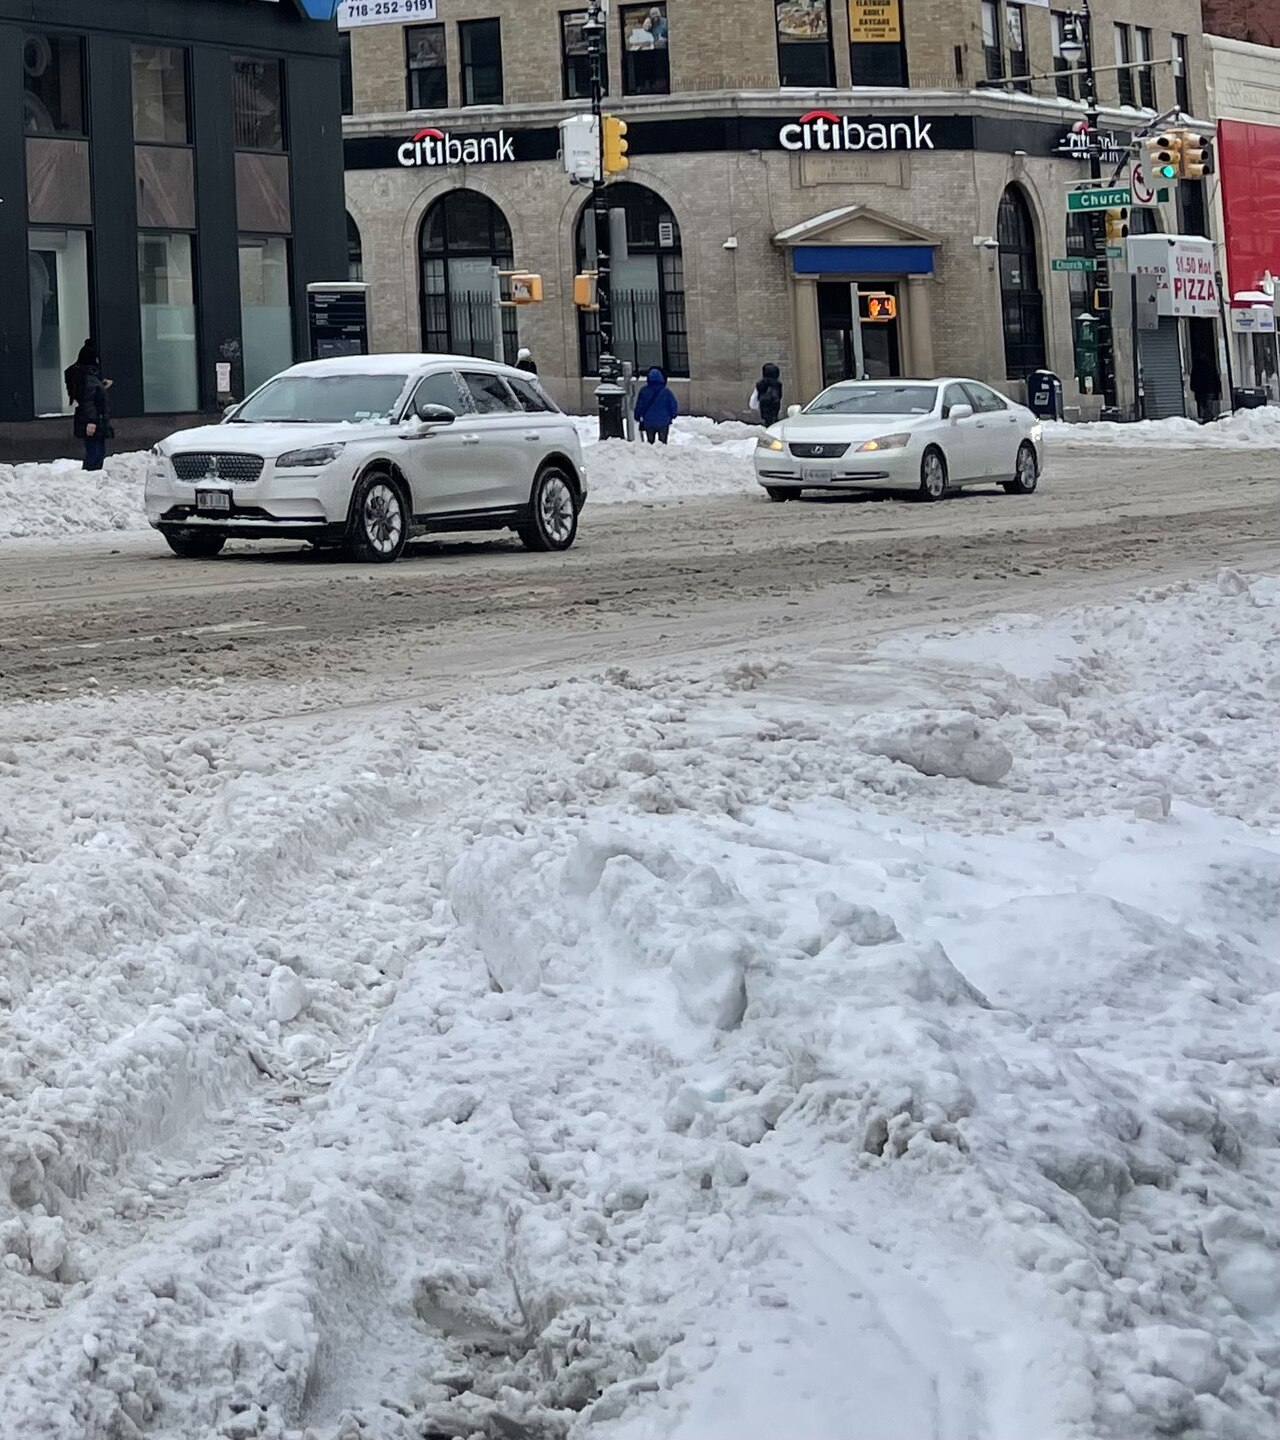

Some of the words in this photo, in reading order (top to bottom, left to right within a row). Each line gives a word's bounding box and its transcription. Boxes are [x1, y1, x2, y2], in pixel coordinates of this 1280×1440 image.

[779, 115, 935, 150] citibank
[397, 130, 516, 166] citibank
[1080, 193, 1130, 206] Church
[1173, 278, 1216, 301] PIZZA
[884, 299, 892, 315] 4
